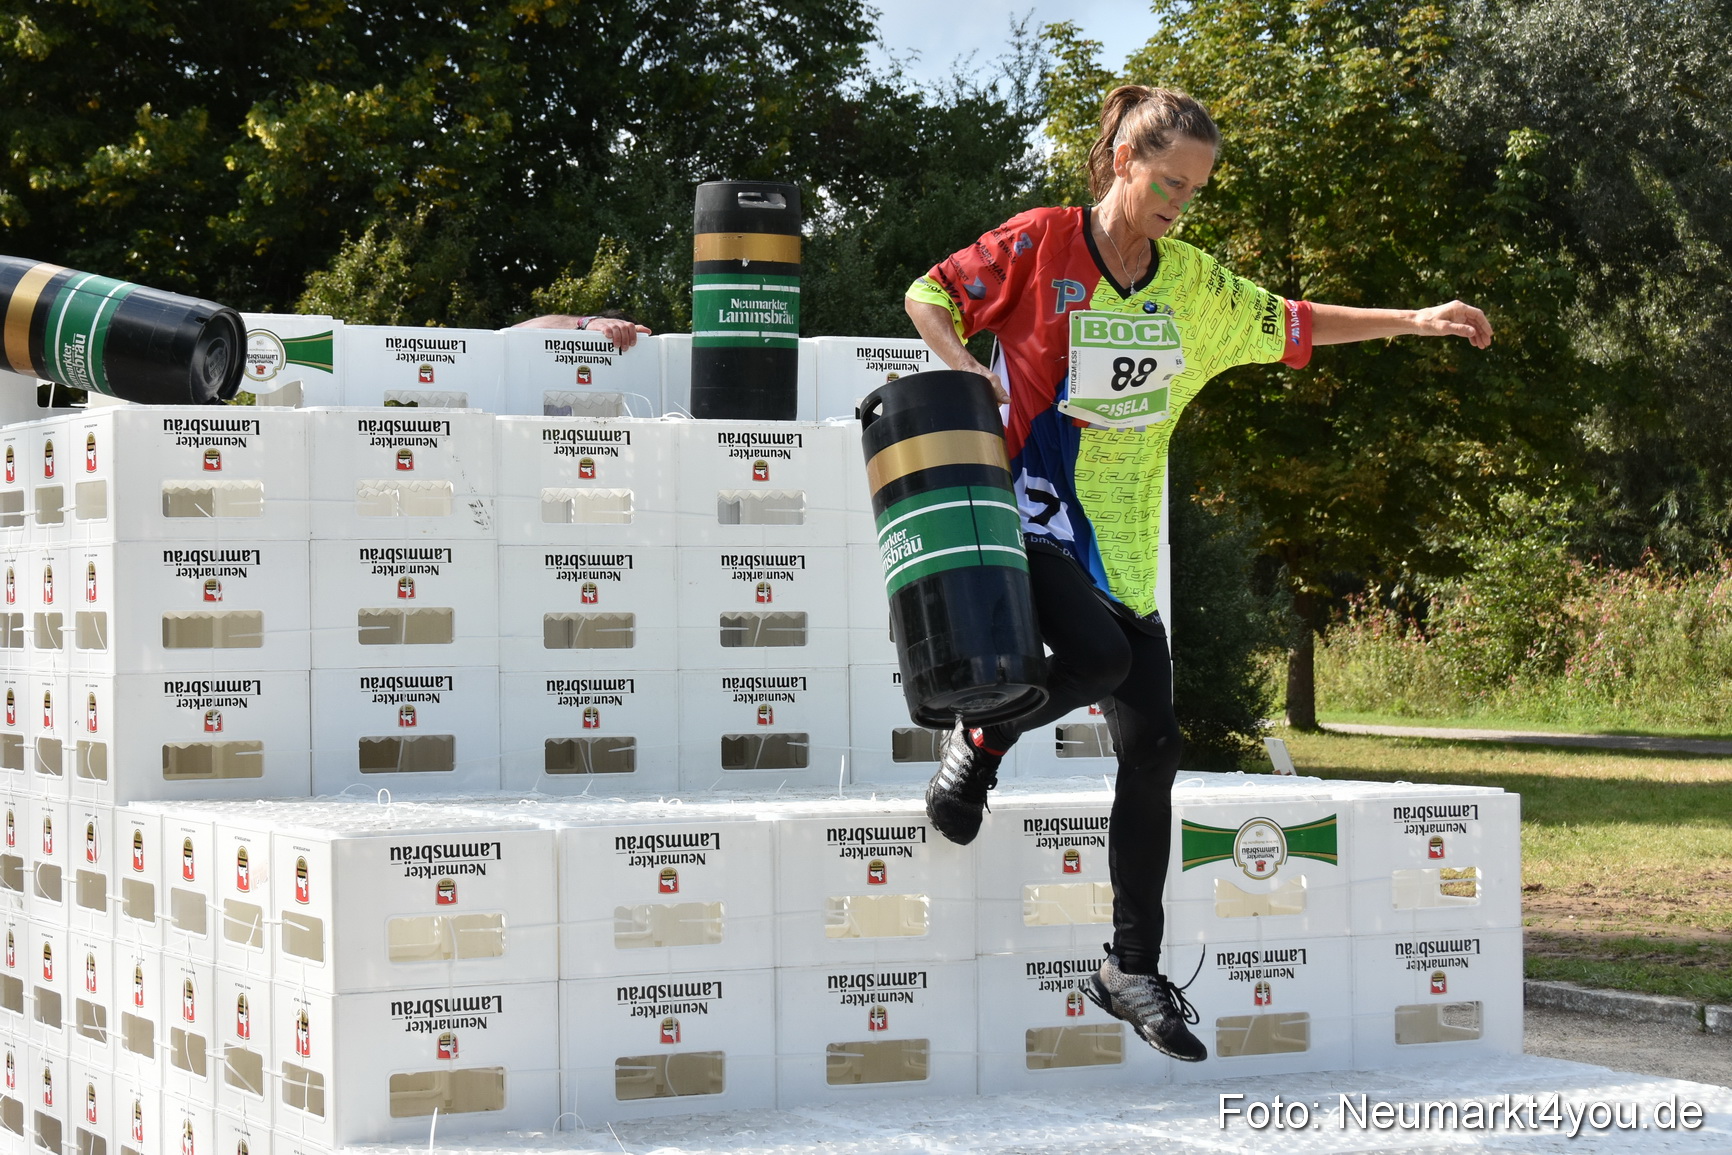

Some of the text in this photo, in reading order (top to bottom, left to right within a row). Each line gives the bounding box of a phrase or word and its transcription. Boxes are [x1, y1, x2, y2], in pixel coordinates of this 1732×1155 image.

[730, 298, 788, 311] Neumarkter
[718, 309, 795, 325] Lammsbräu
[1261, 292, 1279, 336] BMW
[386, 338, 466, 353] Lammsbräu
[73, 332, 93, 390] mmsbräu
[247, 353, 279, 361] Lammsbrä
[396, 353, 456, 364] Neumarkter
[555, 354, 612, 366] Neumarkter
[857, 348, 929, 362] Lammsbräu
[62, 342, 80, 387] umarkter
[866, 362, 920, 372] Neumarkter
[1111, 356, 1158, 392] 88
[1095, 397, 1149, 417] GISELA
[164, 419, 259, 436] Lammsbräu
[359, 420, 450, 436] Lammsbräu
[176, 437, 247, 449] Neumarkter
[370, 437, 438, 449] Neumarkter
[543, 430, 630, 446] Lammsbräu
[718, 432, 802, 448] Lammsbräu
[554, 446, 619, 458] Neumarkter
[729, 448, 792, 460] Neumarkter
[880, 528, 907, 552] markter
[164, 550, 260, 566] Lammsbräu
[360, 548, 451, 564] Lammsbräu
[545, 555, 632, 570] Lammsbräu
[721, 555, 805, 570] Lammsbräu
[882, 535, 924, 574] msbräu
[176, 568, 248, 580] Neumarkter
[372, 565, 440, 577] Neumarkter
[557, 571, 621, 583] Neumarkter
[732, 570, 795, 582] Neumarkter
[165, 680, 260, 697] Lammsbräu
[361, 676, 452, 693] Lammsbräu
[547, 679, 634, 695] Lammsbräu
[723, 677, 806, 692] Lammsbräu
[177, 698, 248, 711] Neumarkter
[372, 693, 440, 705] Neumarkter
[558, 696, 623, 708] Neumarkter
[733, 693, 796, 705] Neumarkter
[1394, 805, 1478, 822] Lammsbräu
[1023, 815, 1109, 837] ammsbräu
[1405, 823, 1467, 837] Neumarkter
[616, 833, 720, 852] Lammsbräu
[827, 826, 926, 845] Lammsbräu
[1035, 835, 1106, 849] Neumarkter
[390, 843, 501, 863] Lammsbräu
[840, 846, 912, 860] Neumarkter
[1241, 845, 1280, 855] Lammsbräu
[629, 853, 706, 869] Neumarkter
[405, 864, 486, 880] Neumarkter
[1396, 939, 1480, 957] Lammsbräu
[1217, 949, 1306, 968] Lammsbräu
[1406, 958, 1469, 972] Neumarkter
[1026, 958, 1106, 980] mmsbräu
[1229, 968, 1295, 983] Neumarkter
[828, 972, 927, 991] Lammsbräu
[1038, 977, 1086, 992] markter
[617, 982, 722, 1003] Lammsbräu
[841, 992, 913, 1007] Neumarkter
[391, 996, 502, 1017] Lammsbräu
[631, 1002, 708, 1019] Neumarkter
[406, 1017, 488, 1034] Neumarkter
